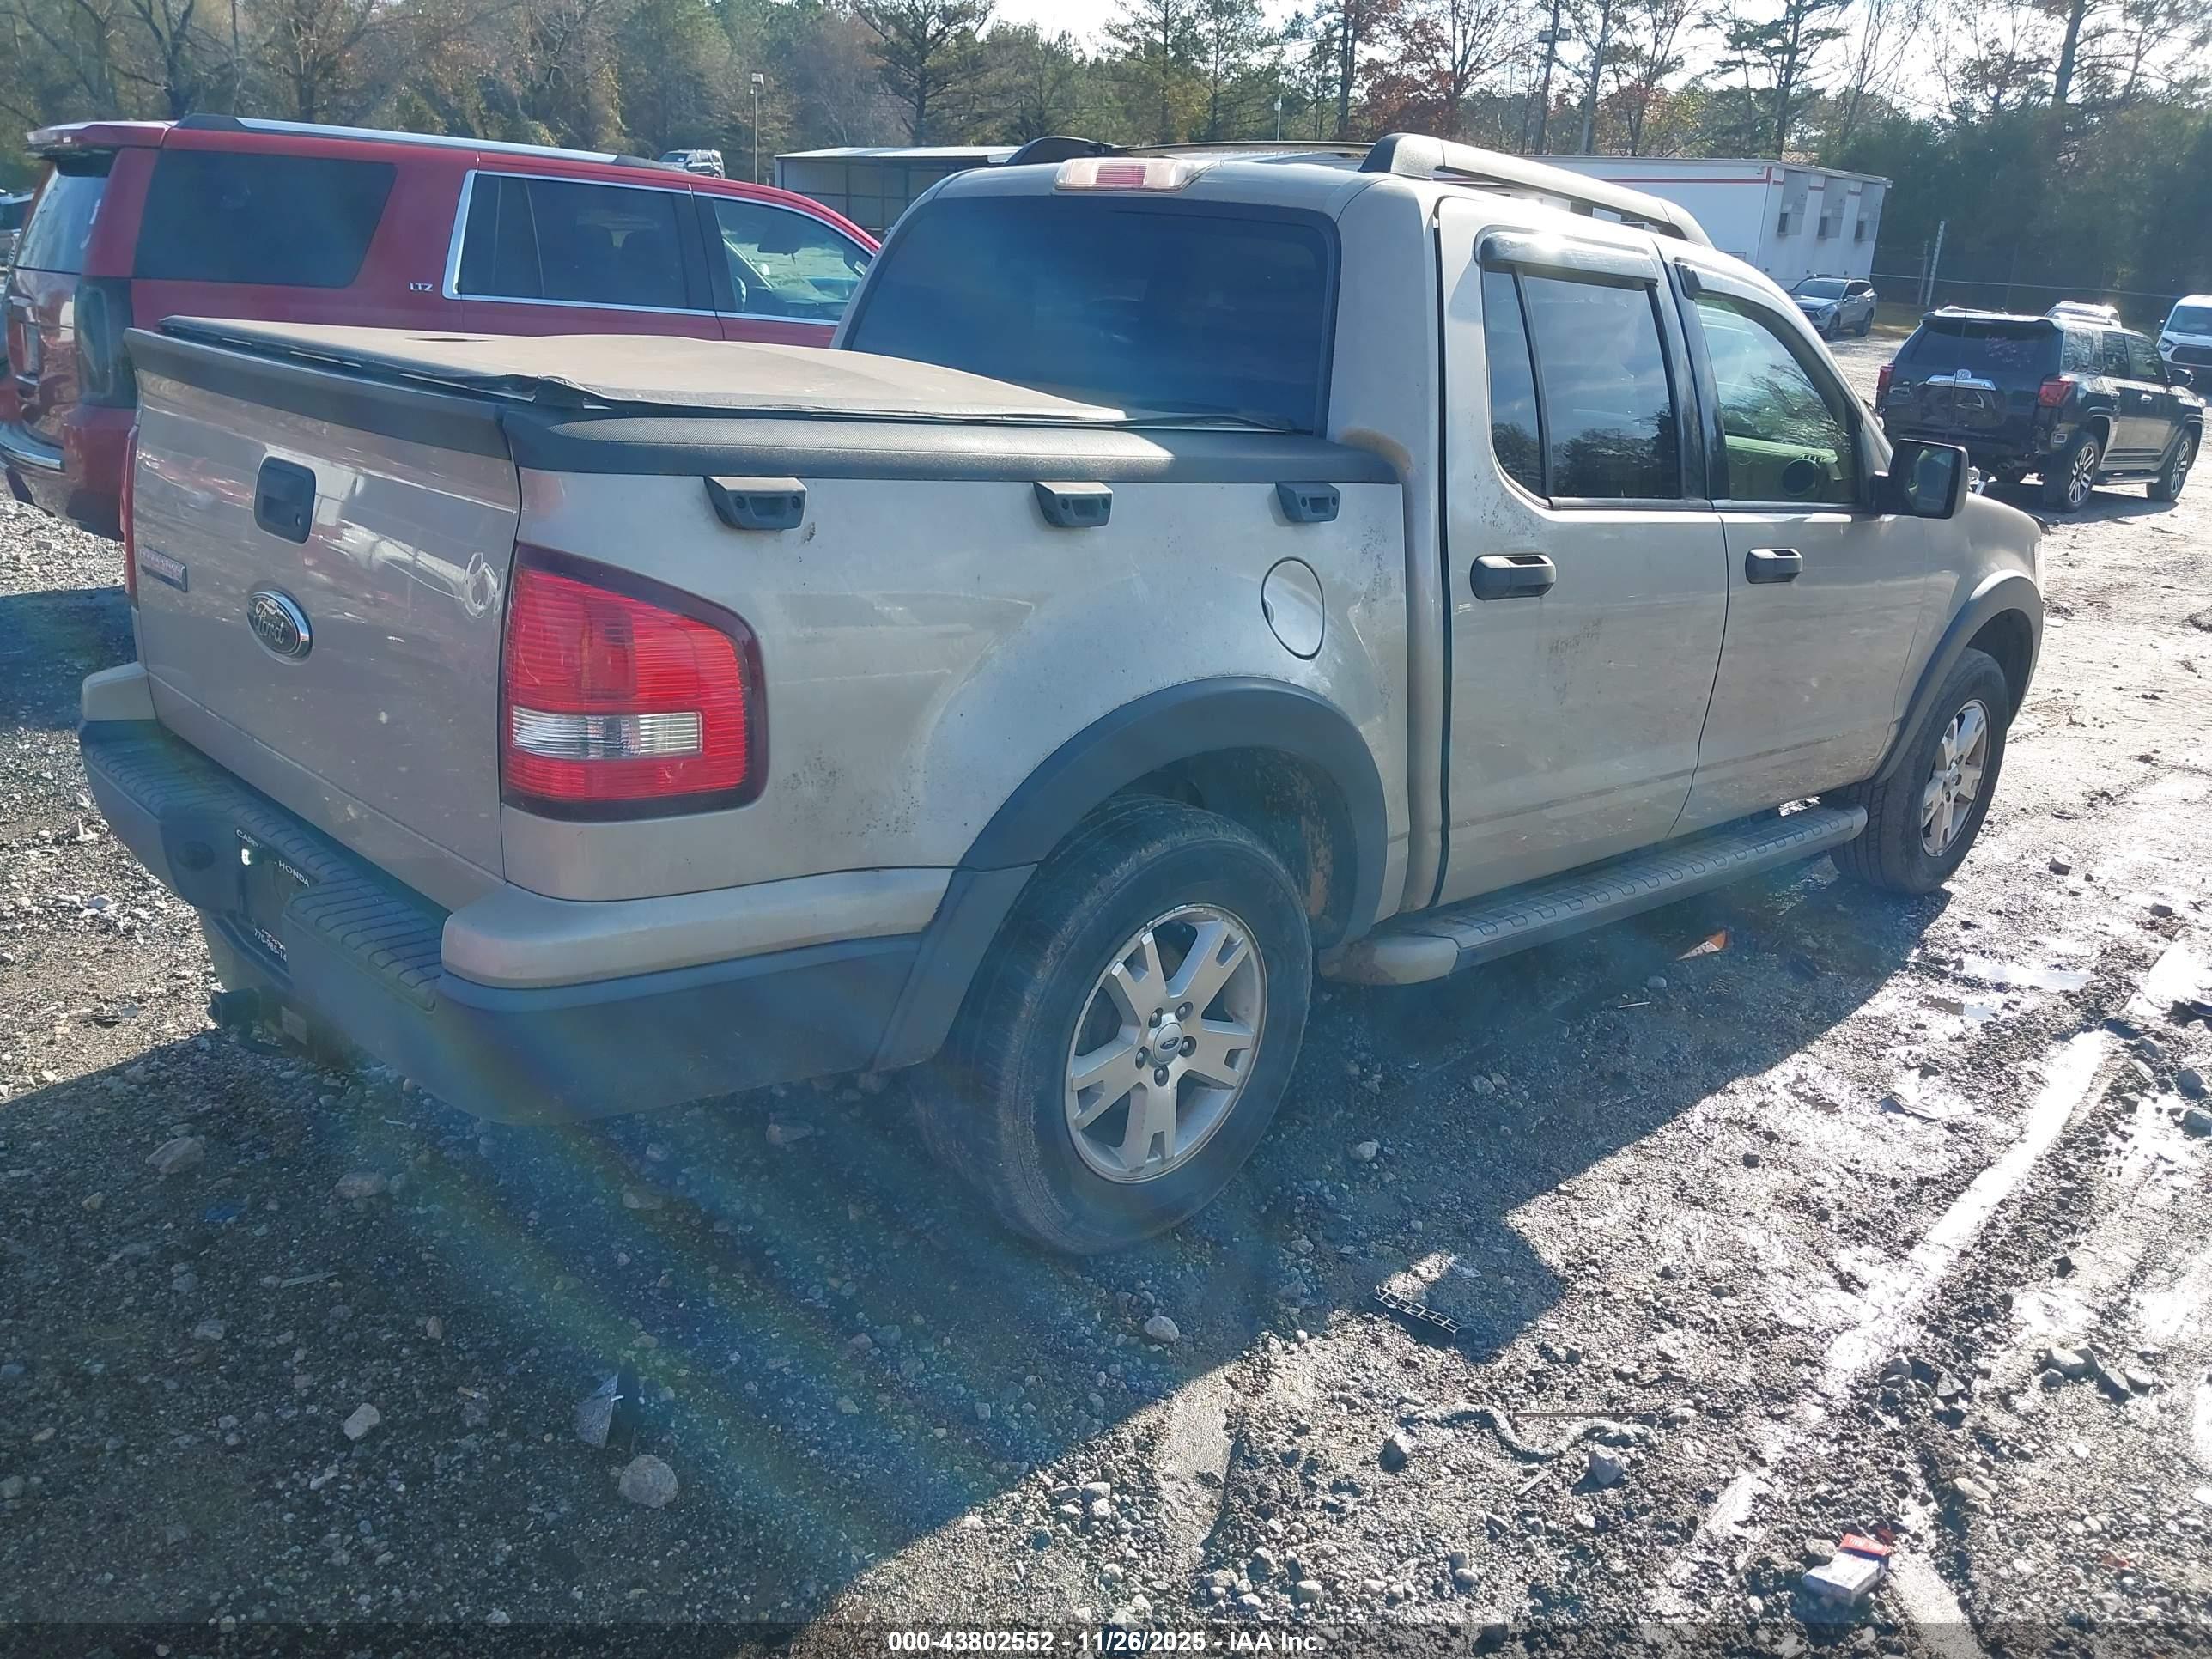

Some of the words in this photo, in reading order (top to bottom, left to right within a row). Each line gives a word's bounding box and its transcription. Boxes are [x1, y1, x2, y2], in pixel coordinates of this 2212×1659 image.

[410, 282, 434, 292] LTZ
[255, 600, 285, 645] Ford
[278, 860, 310, 889] HONDA
